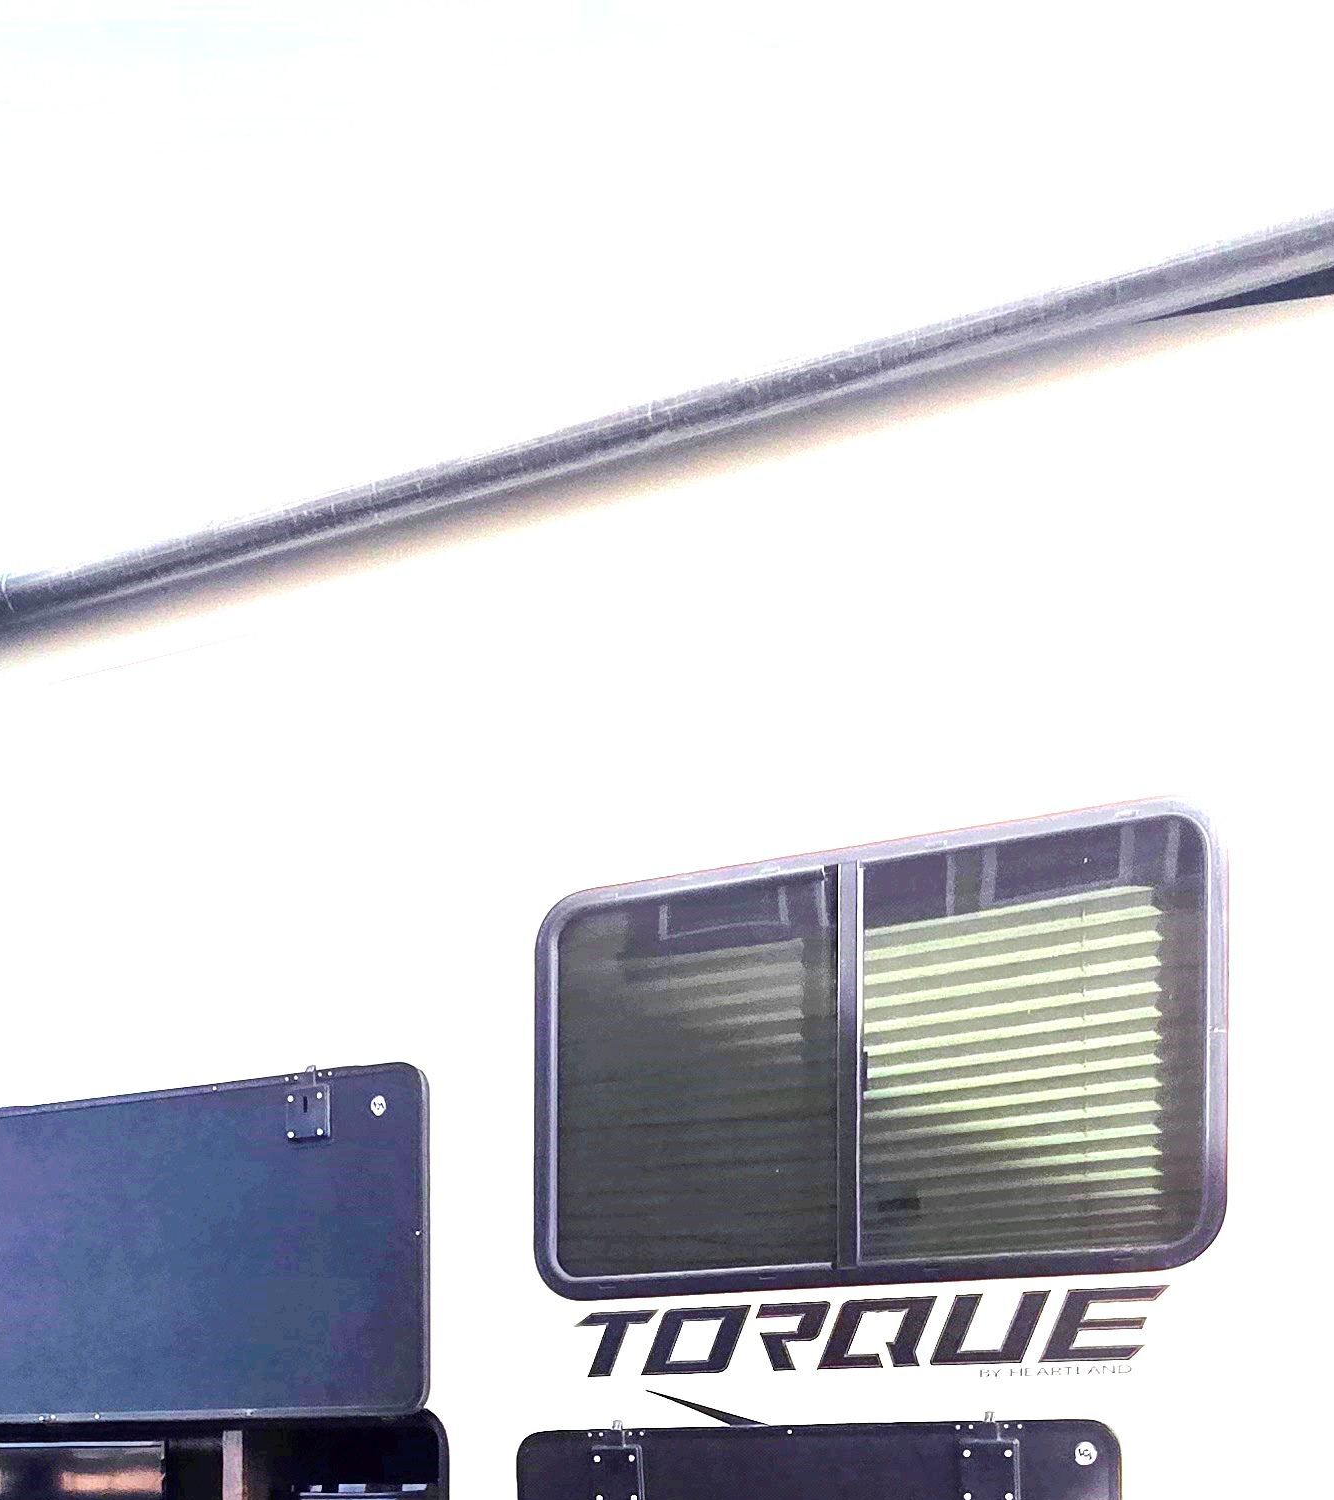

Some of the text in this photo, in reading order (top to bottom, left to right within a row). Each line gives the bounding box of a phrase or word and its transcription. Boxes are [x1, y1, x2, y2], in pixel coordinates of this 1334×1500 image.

[574, 1285, 1170, 1377] TORQUE
[979, 1365, 1133, 1378] BY HEARTLAND
